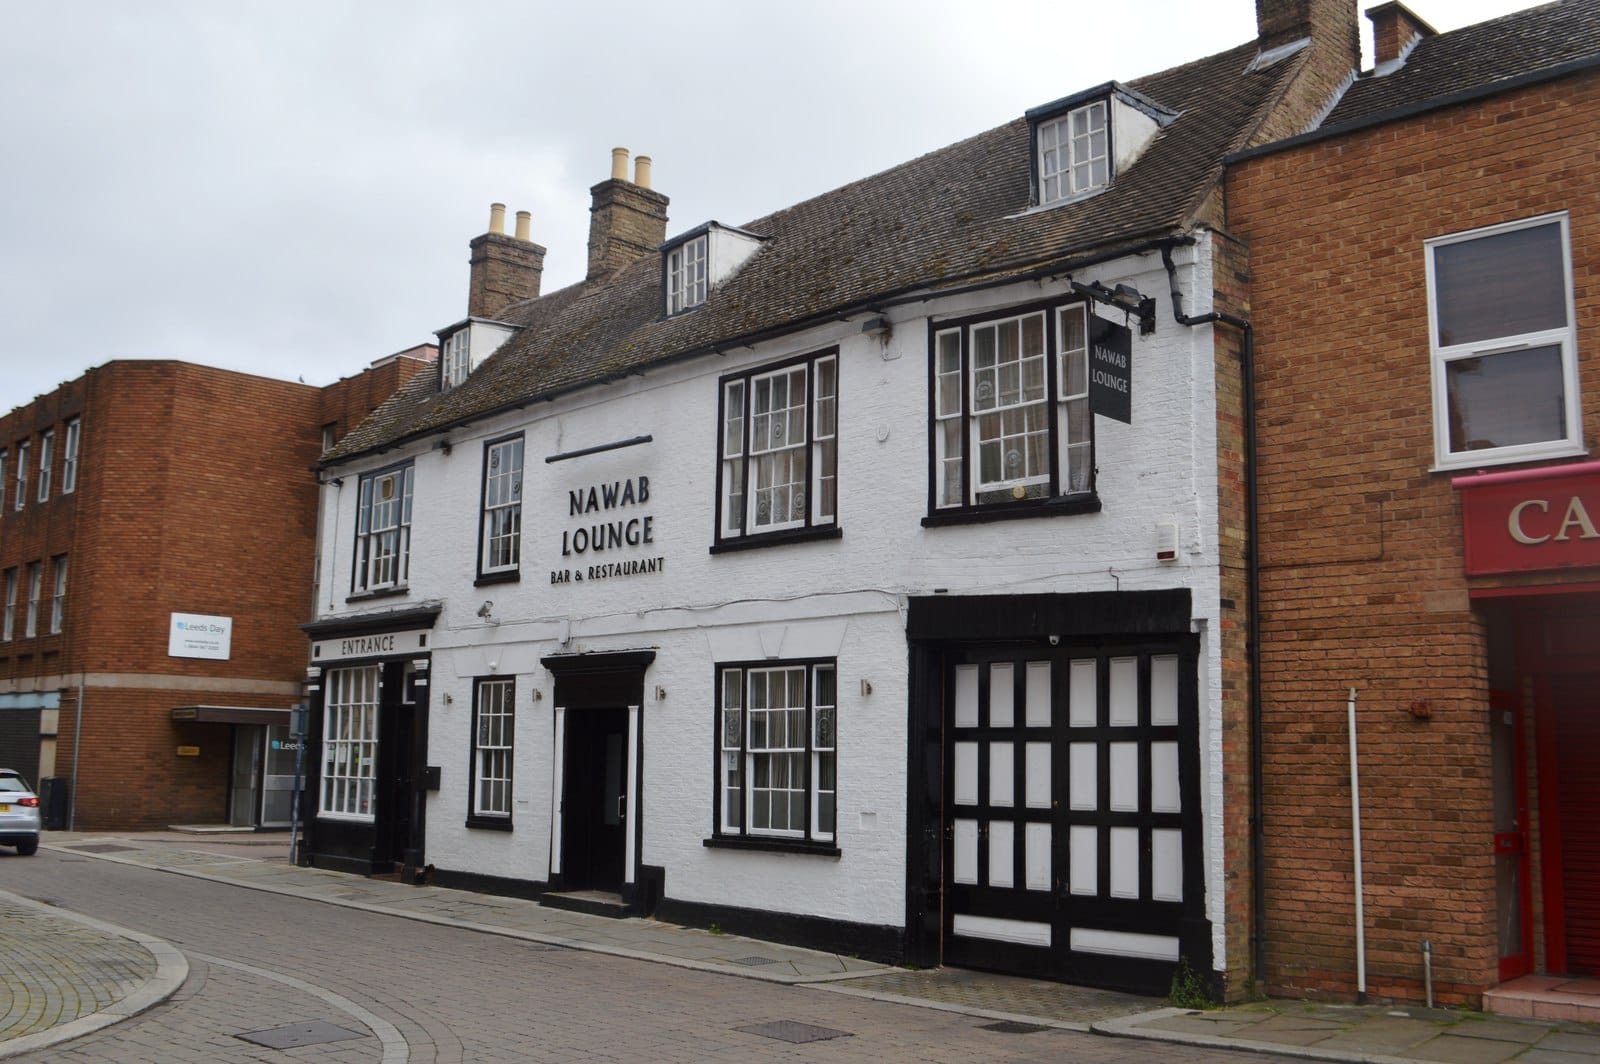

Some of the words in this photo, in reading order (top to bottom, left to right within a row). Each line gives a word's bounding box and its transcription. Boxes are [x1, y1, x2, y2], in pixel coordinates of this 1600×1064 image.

[1095, 345, 1127, 368] NAWAB
[1092, 368, 1128, 393] LOUNGE
[569, 476, 650, 516] NAWAB
[1508, 496, 1600, 545] CA
[562, 516, 654, 556] LOUNGE
[551, 569, 570, 584] BAR
[575, 570, 583, 581] &
[588, 557, 664, 579] RESTAURANT
[185, 622, 208, 632] Leeds
[209, 624, 225, 634] Day
[341, 635, 395, 655] ENTRANCE
